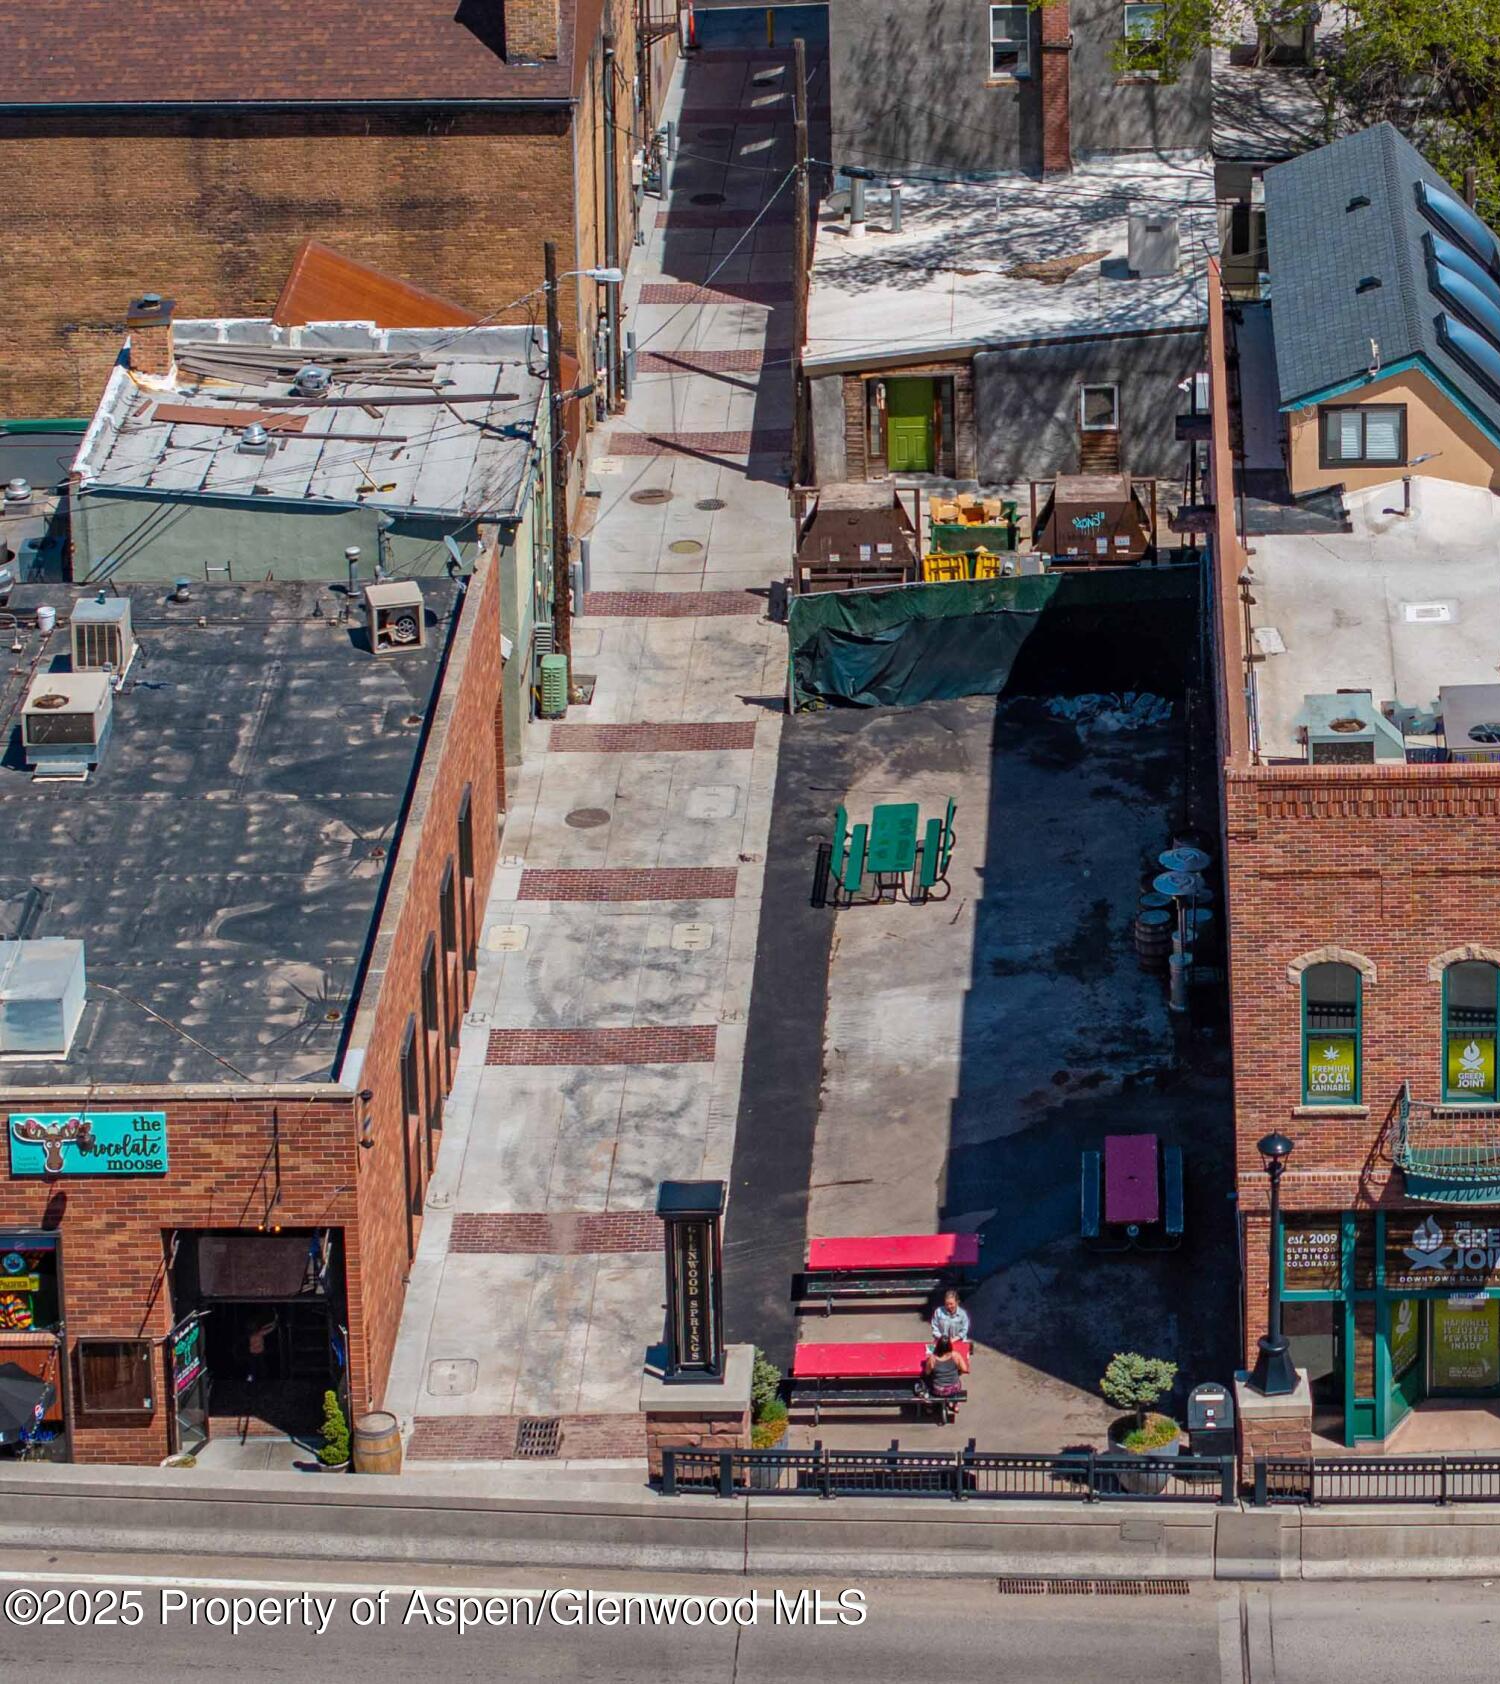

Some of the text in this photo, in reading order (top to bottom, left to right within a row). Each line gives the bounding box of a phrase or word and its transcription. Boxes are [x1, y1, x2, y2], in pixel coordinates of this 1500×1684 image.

[1312, 1065, 1351, 1073] PREMIUM
[1312, 1073, 1351, 1084] LOCAL
[1458, 1079, 1486, 1088] JOINT
[133, 1116, 161, 1131] the
[107, 1158, 163, 1170] moose
[1455, 1221, 1472, 1229] THE
[1287, 1233, 1338, 1244] est. 2009
[1287, 1253, 1336, 1261] SPRINGS
[1399, 1275, 1456, 1283] DOWNTOWN
[690, 1299, 700, 1360] SPRINGS
